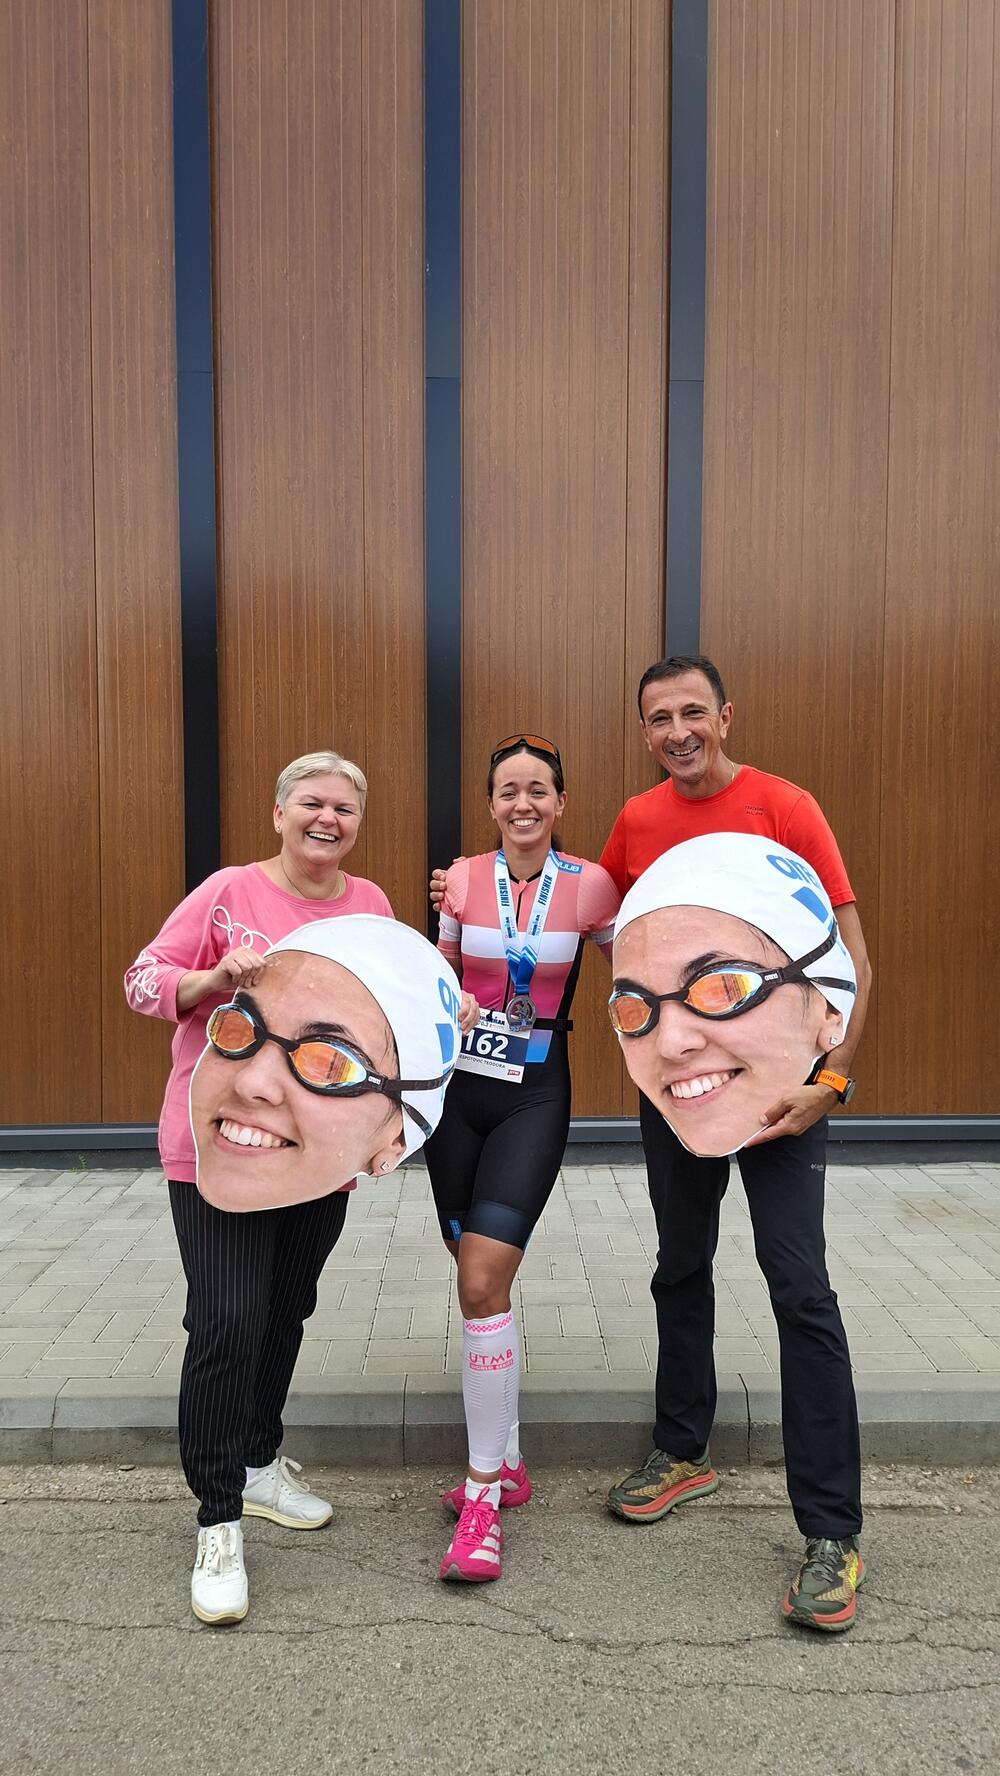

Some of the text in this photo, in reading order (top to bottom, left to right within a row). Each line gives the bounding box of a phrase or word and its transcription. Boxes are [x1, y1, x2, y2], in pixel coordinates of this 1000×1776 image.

[559, 861, 580, 872] UUB
[498, 878, 510, 907] FINISHER
[537, 874, 552, 906] FINISHER
[465, 1029, 509, 1060] 162
[458, 1054, 483, 1064] ESPOTOVIC
[469, 1349, 513, 1365] UTMB
